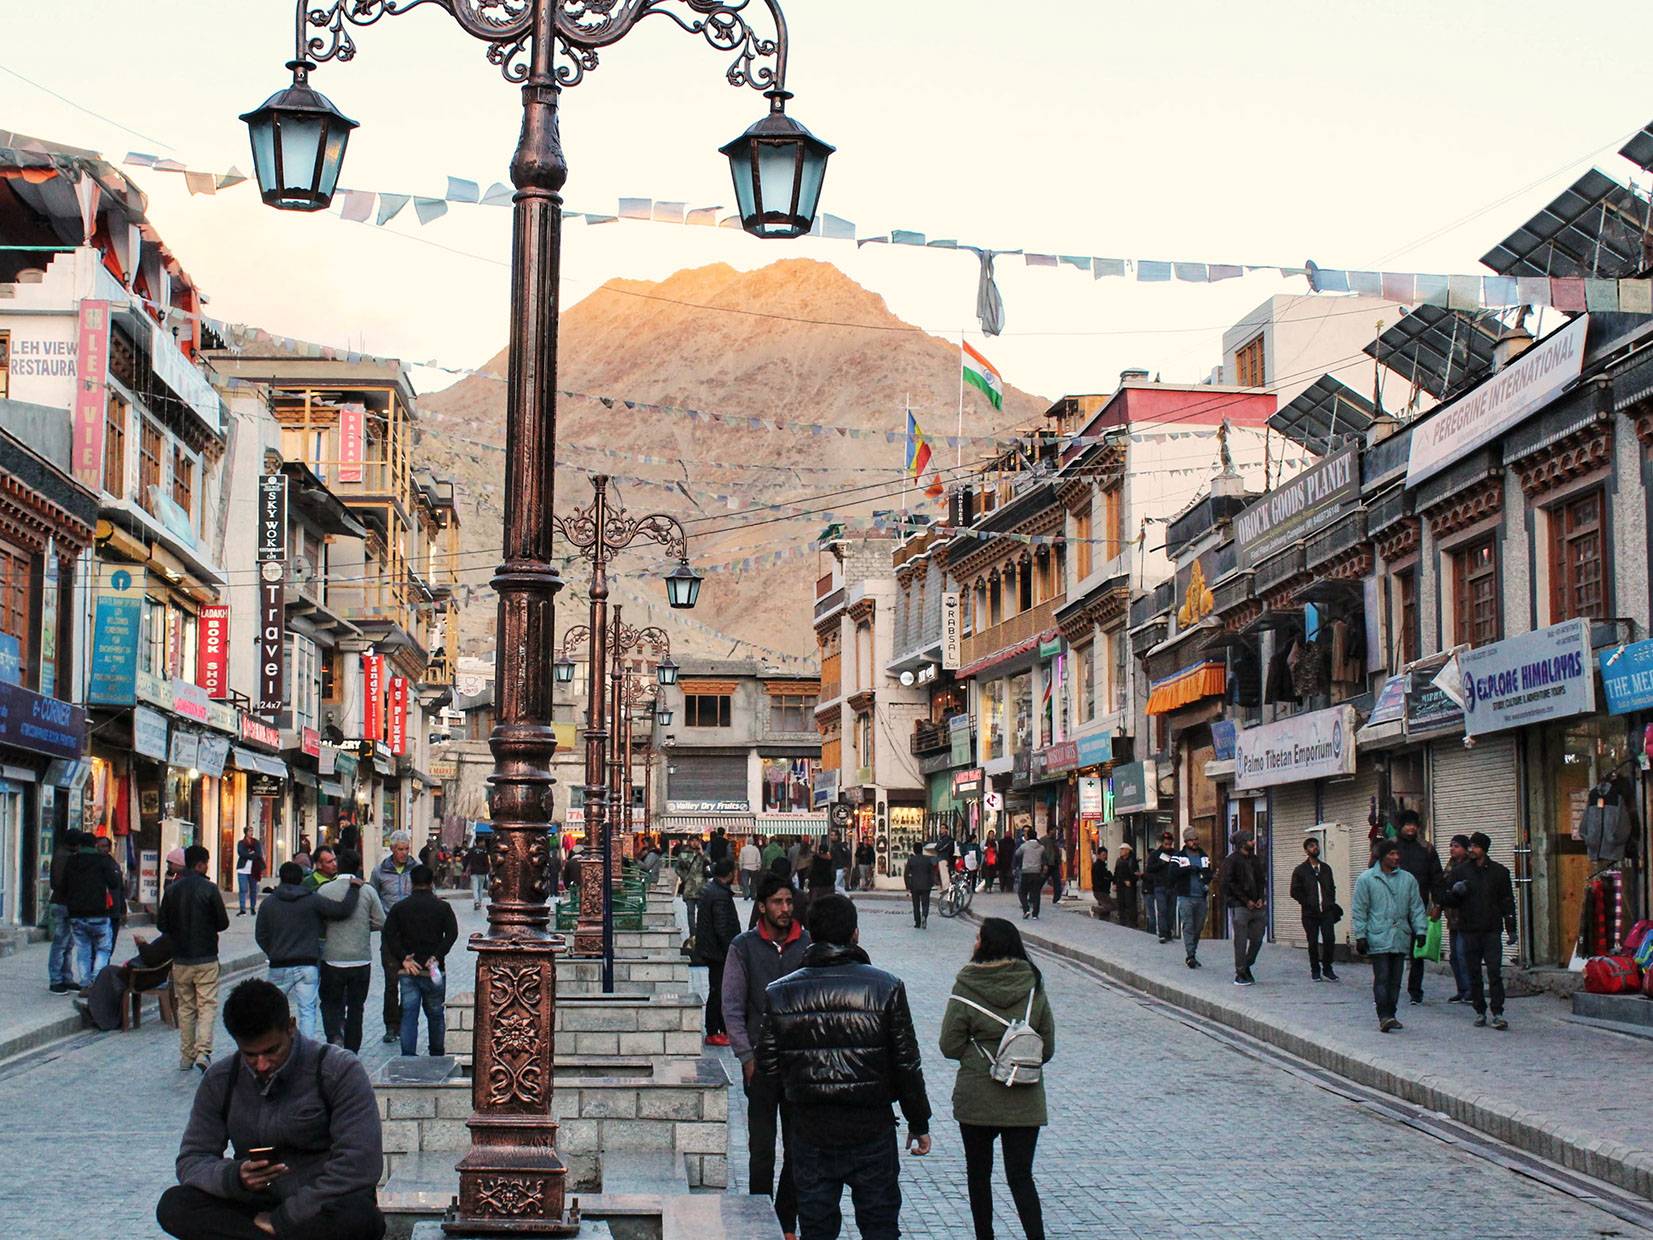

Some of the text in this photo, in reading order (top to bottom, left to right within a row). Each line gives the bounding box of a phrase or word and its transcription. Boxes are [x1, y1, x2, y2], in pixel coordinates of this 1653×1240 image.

[11, 341, 79, 355] LEH VIEW
[11, 359, 79, 376] RESTAURA
[1432, 390, 1488, 446] PEREGRINE
[1488, 332, 1574, 411] INTERNATIONAL
[1271, 481, 1305, 525] GOODS
[1307, 452, 1351, 505] PLANET
[265, 491, 279, 547] SKY WOK
[201, 608, 228, 619] LADAKH
[948, 610, 956, 660] RABSAL
[206, 620, 219, 695] BOOK SHOP
[264, 585, 279, 694] Travel
[370, 656, 379, 702] Tandys
[1476, 650, 1582, 701] EXPLORE HIMALAYAS
[1605, 676, 1631, 699] THE
[259, 700, 281, 710] 24x7
[394, 706, 402, 754] PIZZA
[1243, 739, 1332, 774] Palmo Tibetan Emporium
[568, 811, 584, 820] Th
[676, 802, 740, 811] Valley Dry Fruits
